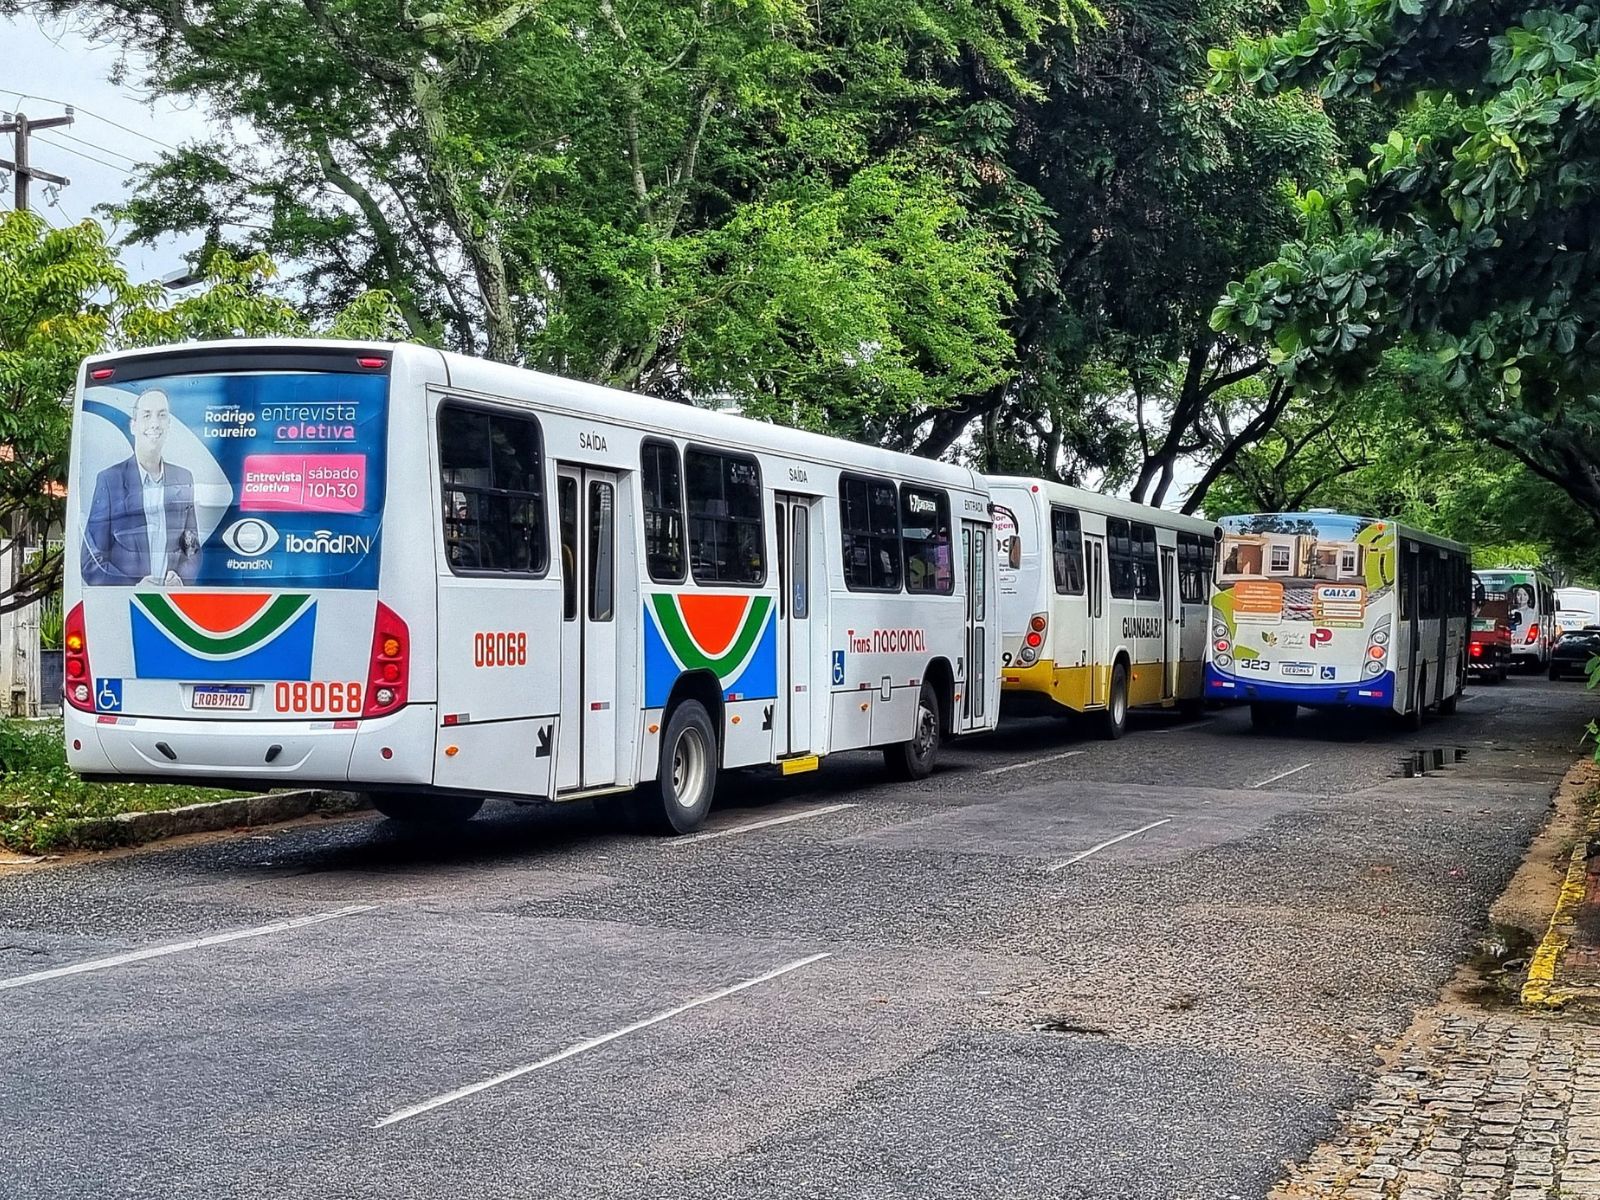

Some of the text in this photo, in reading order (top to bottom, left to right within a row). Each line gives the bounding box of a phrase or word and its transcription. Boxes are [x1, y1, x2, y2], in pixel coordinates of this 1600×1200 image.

[204, 409, 256, 424] Rodrigo
[261, 405, 356, 421] entrevista
[204, 425, 257, 438] Loureiro
[276, 423, 355, 439] coletiva
[579, 430, 608, 452] SAÍDA
[246, 471, 302, 482] Entrevista
[308, 467, 359, 480] sábado
[788, 465, 809, 483] SAÍDA
[245, 482, 290, 493] Coletiva
[307, 483, 358, 498] 10h30
[964, 499, 984, 513] ENTRADA
[227, 559, 273, 570] #bandRN
[1323, 588, 1357, 598] CAIXA
[474, 632, 527, 668] 08068
[1241, 658, 1271, 671] 323
[275, 682, 363, 713] 08068
